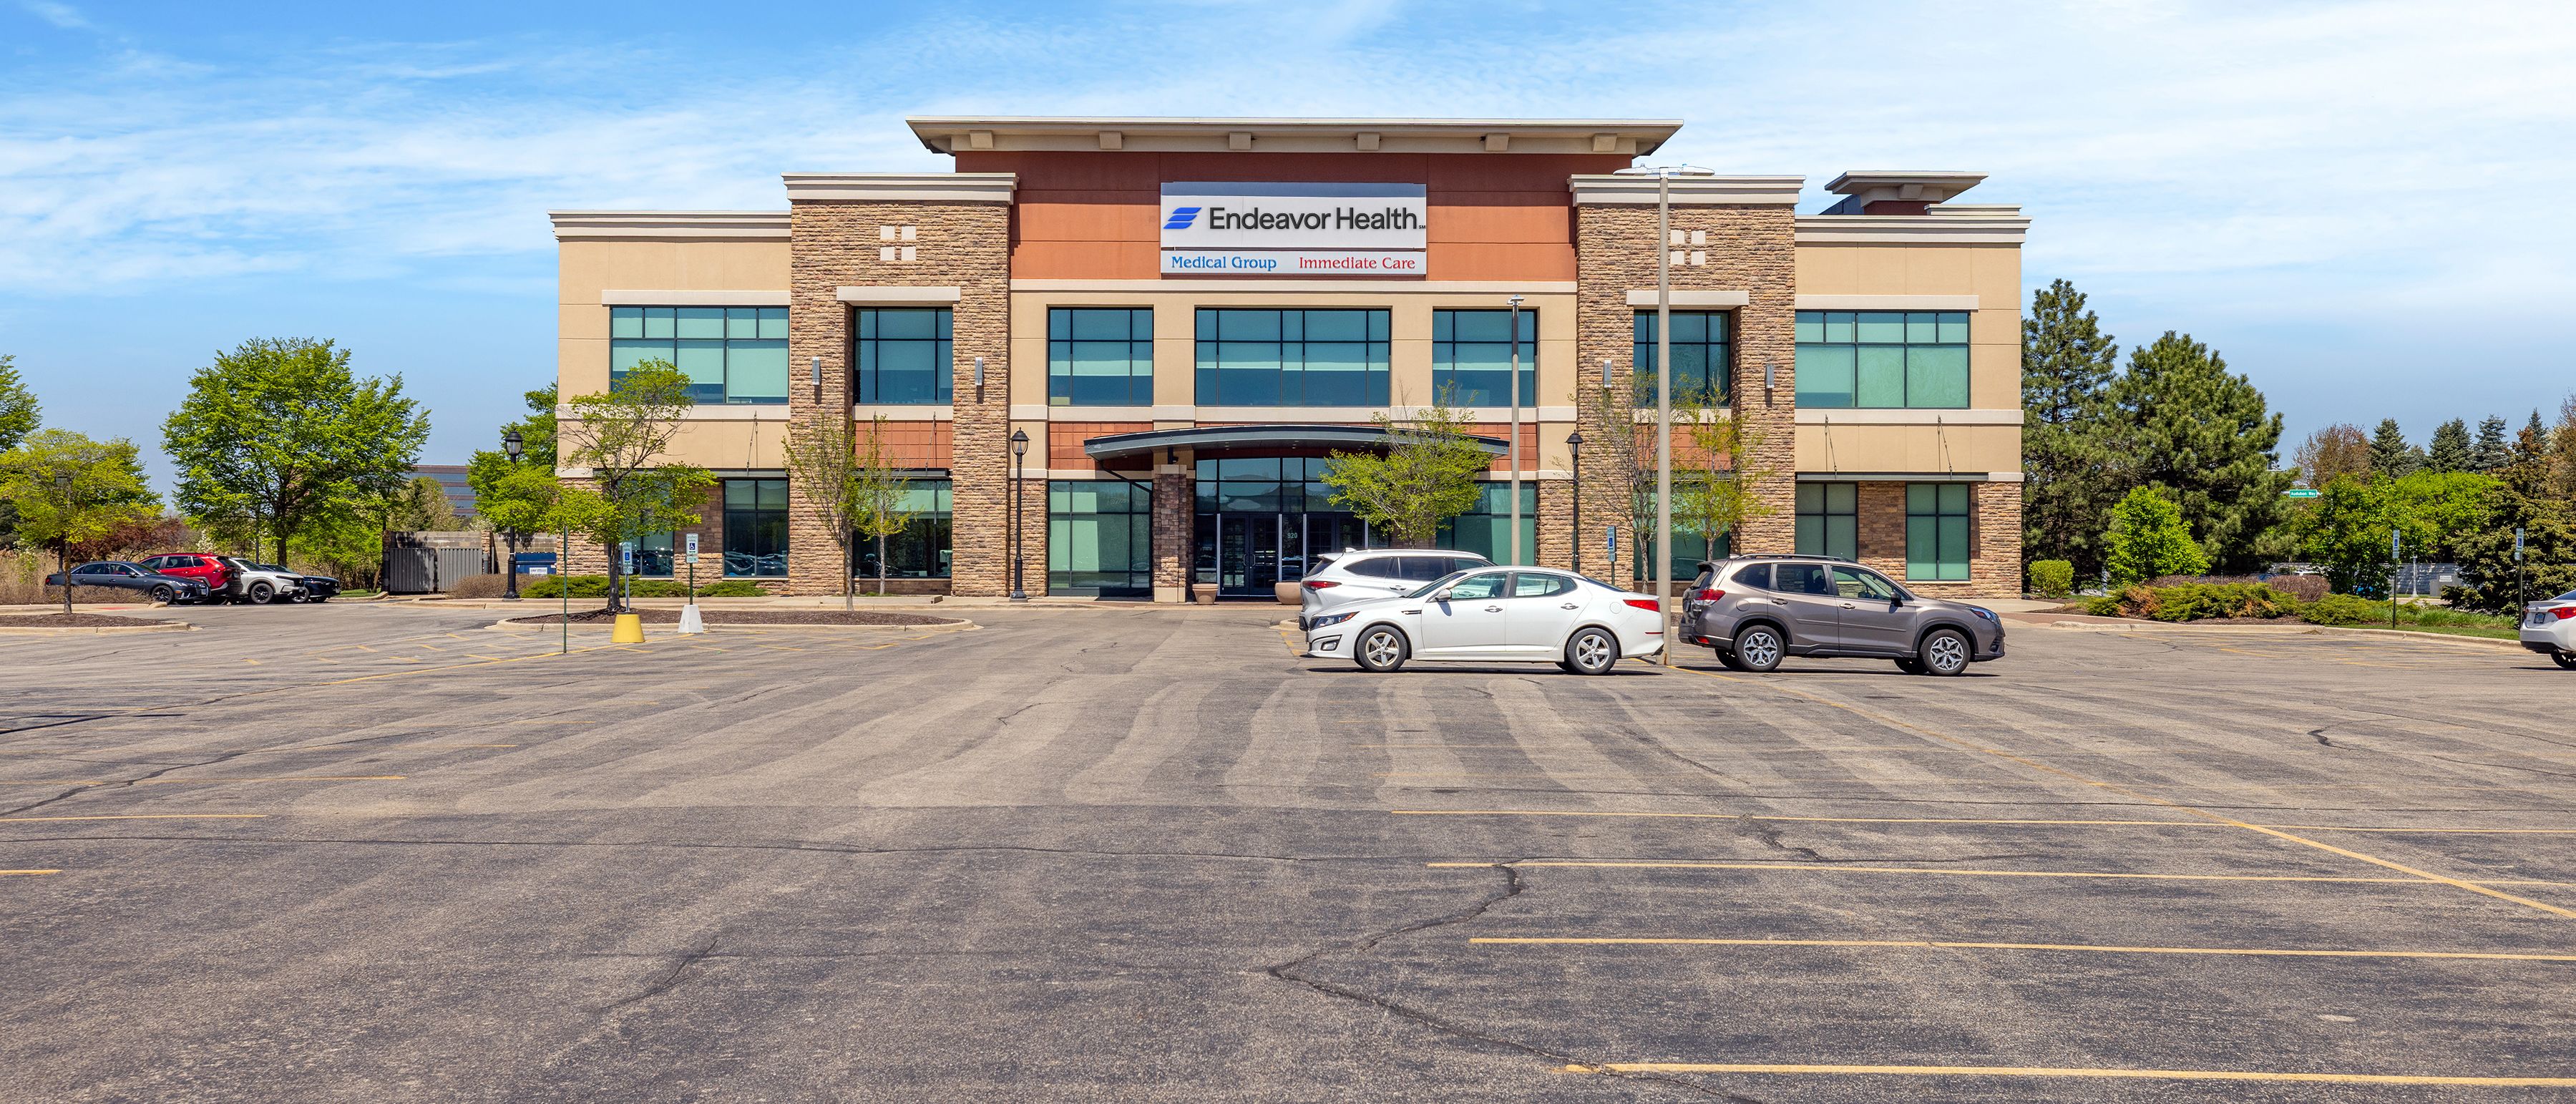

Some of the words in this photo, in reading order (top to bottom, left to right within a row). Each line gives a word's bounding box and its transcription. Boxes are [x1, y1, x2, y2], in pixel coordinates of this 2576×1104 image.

[1209, 207, 1331, 230] Endeavor
[1337, 207, 1417, 230] Health
[1171, 256, 1226, 268] Medical
[1231, 256, 1277, 270] Group
[1299, 257, 1377, 269] Immediate
[1382, 258, 1415, 269] Care
